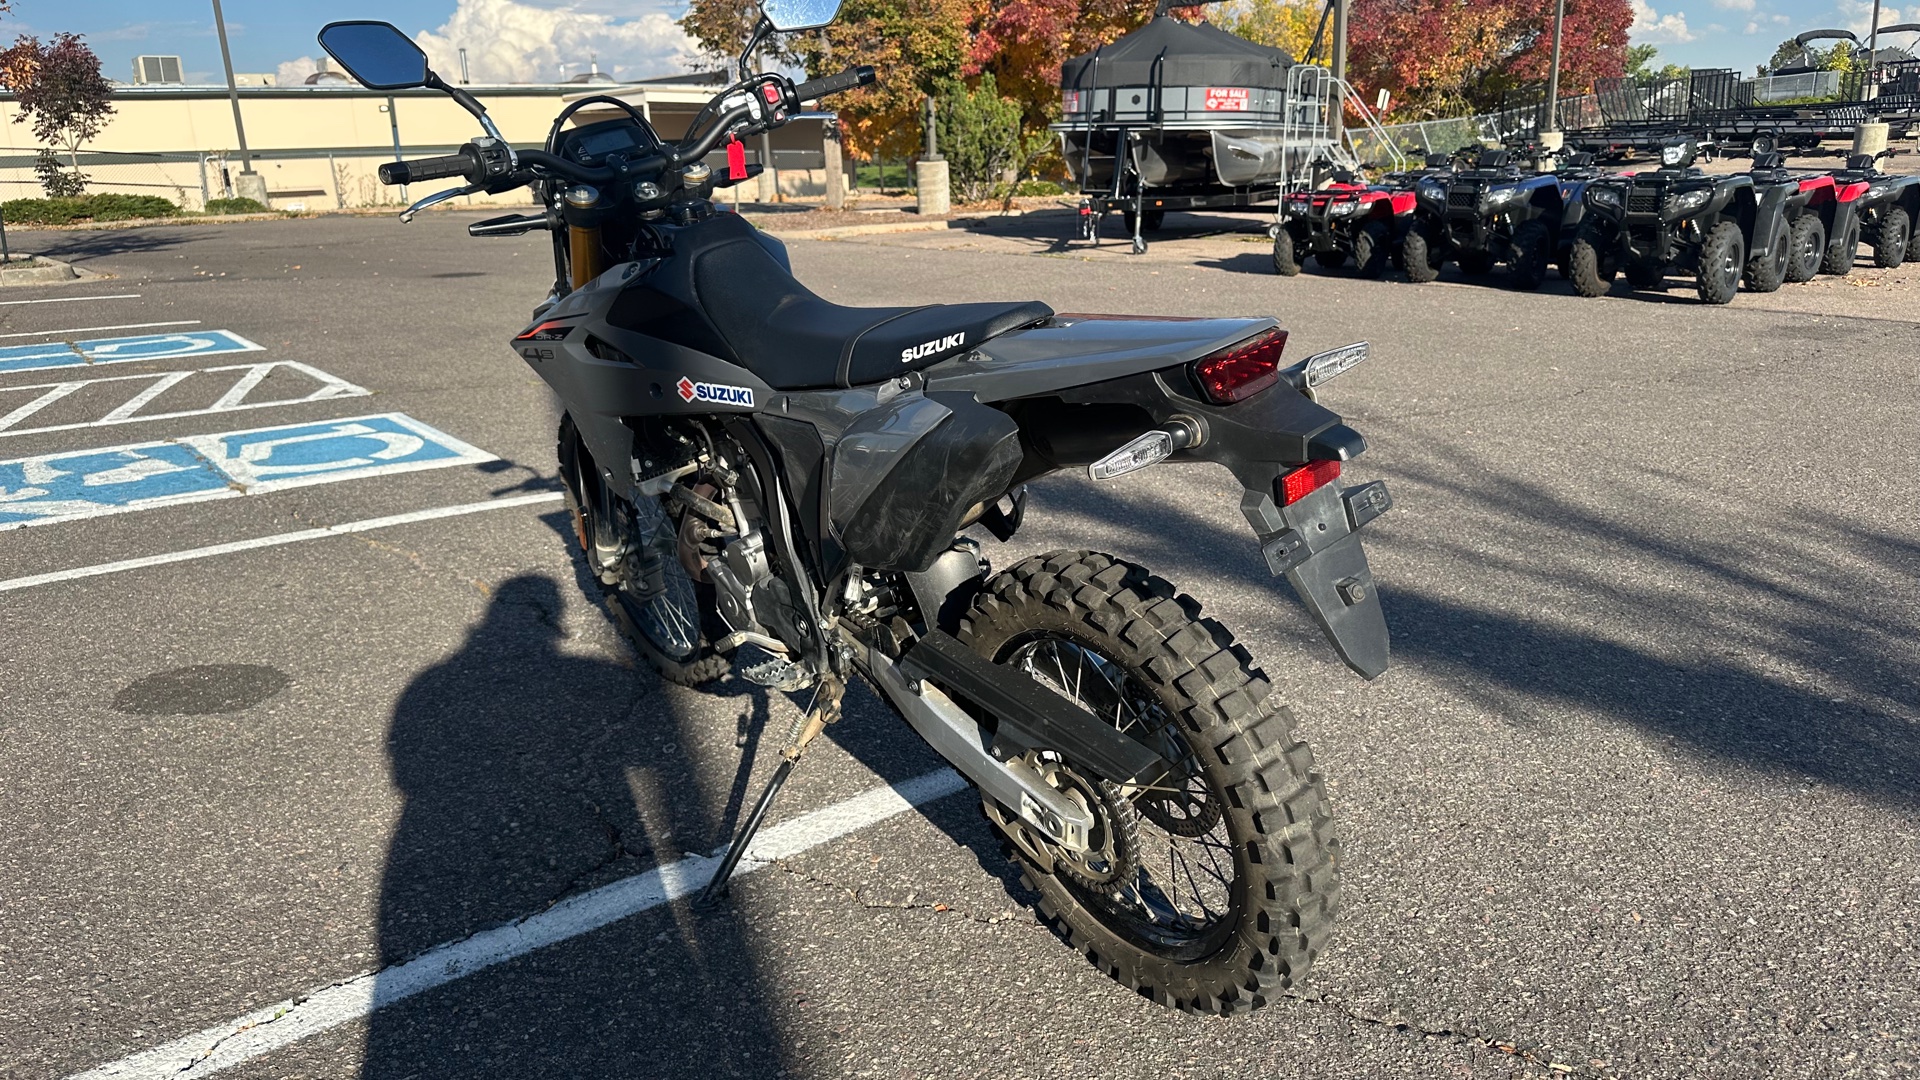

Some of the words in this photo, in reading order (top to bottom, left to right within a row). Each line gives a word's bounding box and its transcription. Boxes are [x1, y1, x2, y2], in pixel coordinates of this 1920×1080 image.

[1210, 89, 1228, 98] FOR
[1229, 89, 1246, 98] SALE
[901, 332, 965, 363] SUZUKI
[696, 384, 752, 405] SUZUKI
